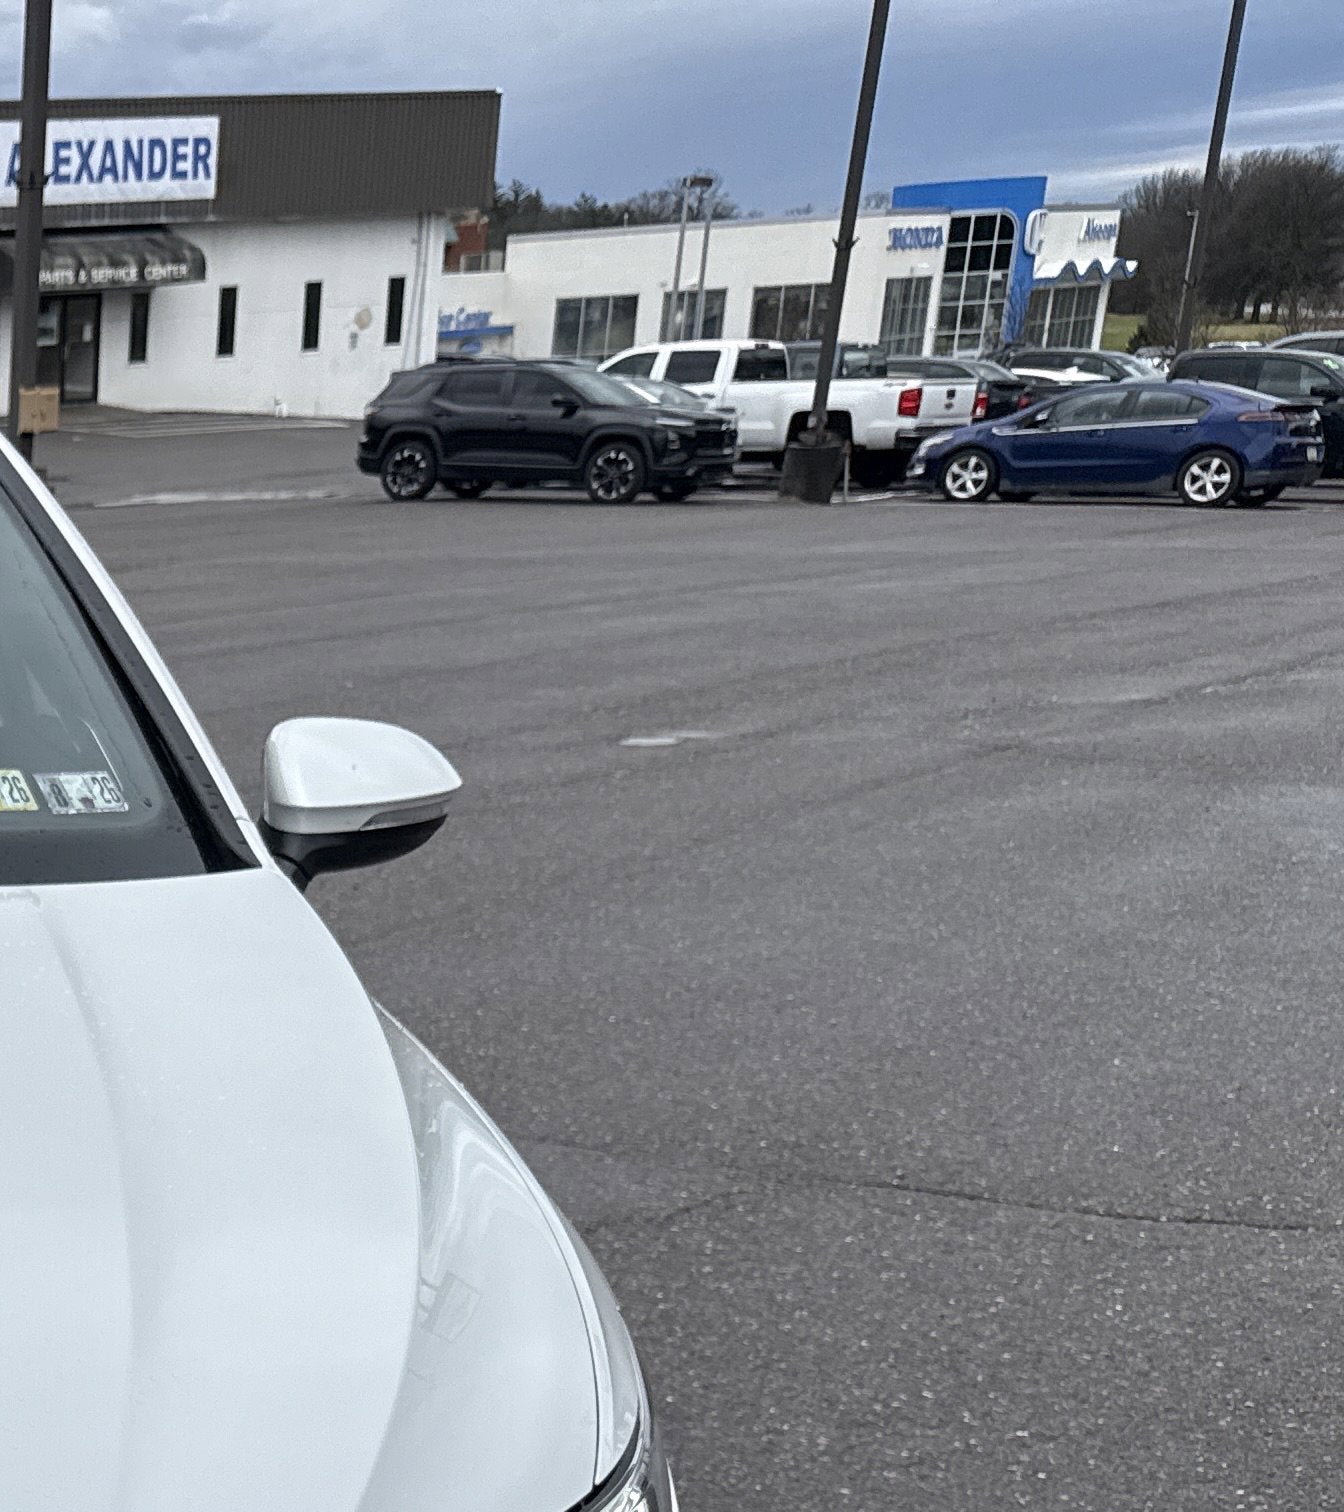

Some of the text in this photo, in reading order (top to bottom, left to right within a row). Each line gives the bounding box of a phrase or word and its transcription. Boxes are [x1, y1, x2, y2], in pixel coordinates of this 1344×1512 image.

[7, 136, 212, 187] AEXANDER
[1, 776, 30, 804] 26
[91, 776, 120, 805] 26
